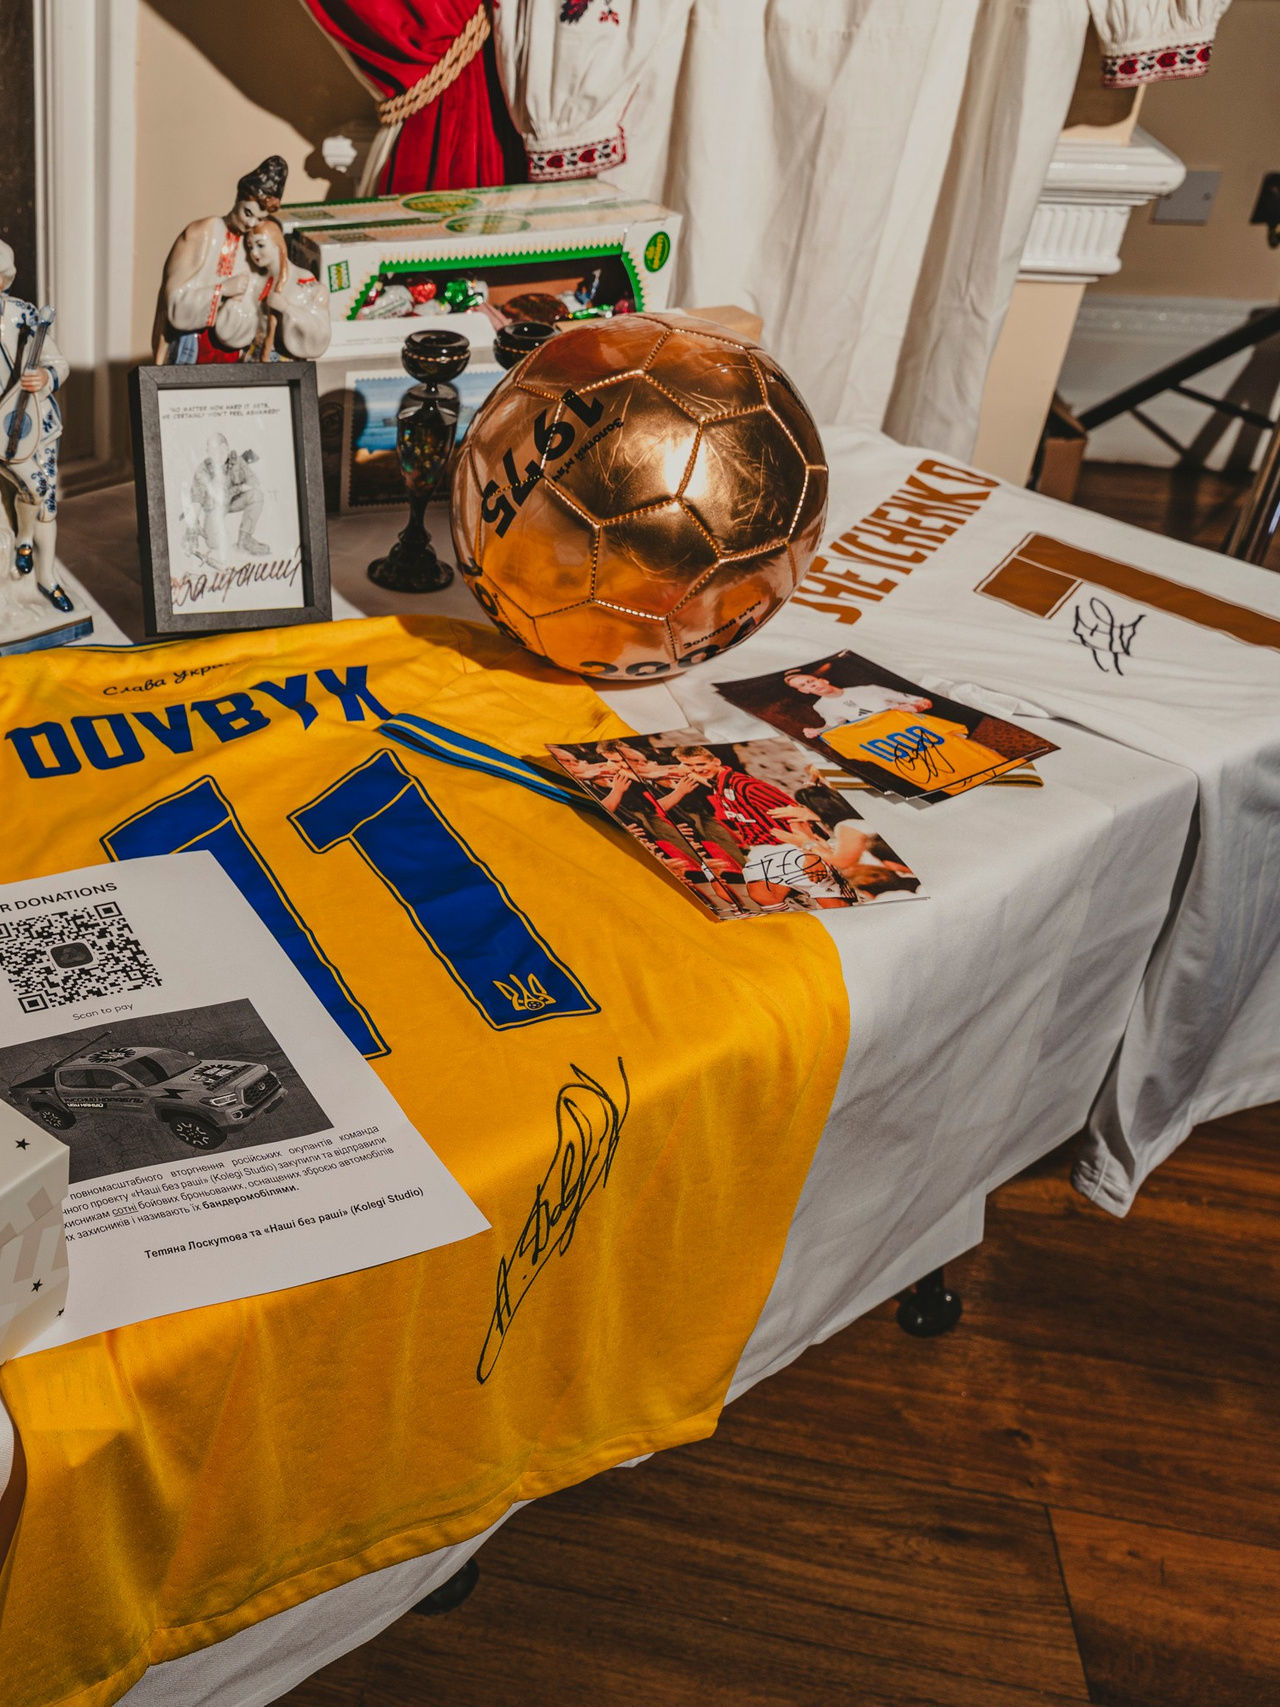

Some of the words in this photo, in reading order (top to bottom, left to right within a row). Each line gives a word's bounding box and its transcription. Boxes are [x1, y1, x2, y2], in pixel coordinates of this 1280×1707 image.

[480, 388, 605, 539] 1975
[572, 416, 625, 461] Золотий
[5, 665, 395, 779] DOVBYK
[103, 679, 167, 696] Слава
[14, 882, 118, 910] DONATIONS
[72, 1010, 99, 1021] Scan
[114, 1003, 133, 1014] pay
[63, 1210, 111, 1229] хисникам
[111, 1202, 139, 1218] сотні
[137, 1195, 180, 1210] бойових
[179, 1183, 248, 1202] броньованих,
[247, 1171, 302, 1188] оснащених
[301, 1162, 338, 1177] зброєю
[338, 1147, 395, 1168] автомобілів
[69, 1173, 164, 1201] повномасштабного
[170, 1162, 226, 1178] вторгнення
[231, 1150, 283, 1168] російських
[288, 1138, 333, 1155] окупантів
[338, 1125, 380, 1142] команда
[89, 1193, 129, 1209] проекту
[130, 1184, 162, 1198] «Наші
[161, 1182, 180, 1192] без
[180, 1176, 209, 1190] раші»
[209, 1169, 244, 1185] (Kolegi
[242, 1162, 278, 1176] Studio)
[277, 1154, 322, 1170] закупили
[320, 1151, 334, 1159] та
[333, 1137, 387, 1157] відправили
[76, 1218, 131, 1239] захисників
[130, 1215, 136, 1224] і
[136, 1207, 191, 1223] називають
[189, 1203, 202, 1212] їх
[201, 1185, 300, 1210] бандеромобілями.
[143, 1244, 187, 1259] Тетяна
[188, 1232, 249, 1251] Лоскутова
[248, 1229, 263, 1237] та
[263, 1219, 297, 1234] «Наші
[297, 1217, 317, 1227] без
[318, 1208, 349, 1224] раші»
[350, 1196, 387, 1216] (Kolegi
[386, 1186, 424, 1204] Studio)
